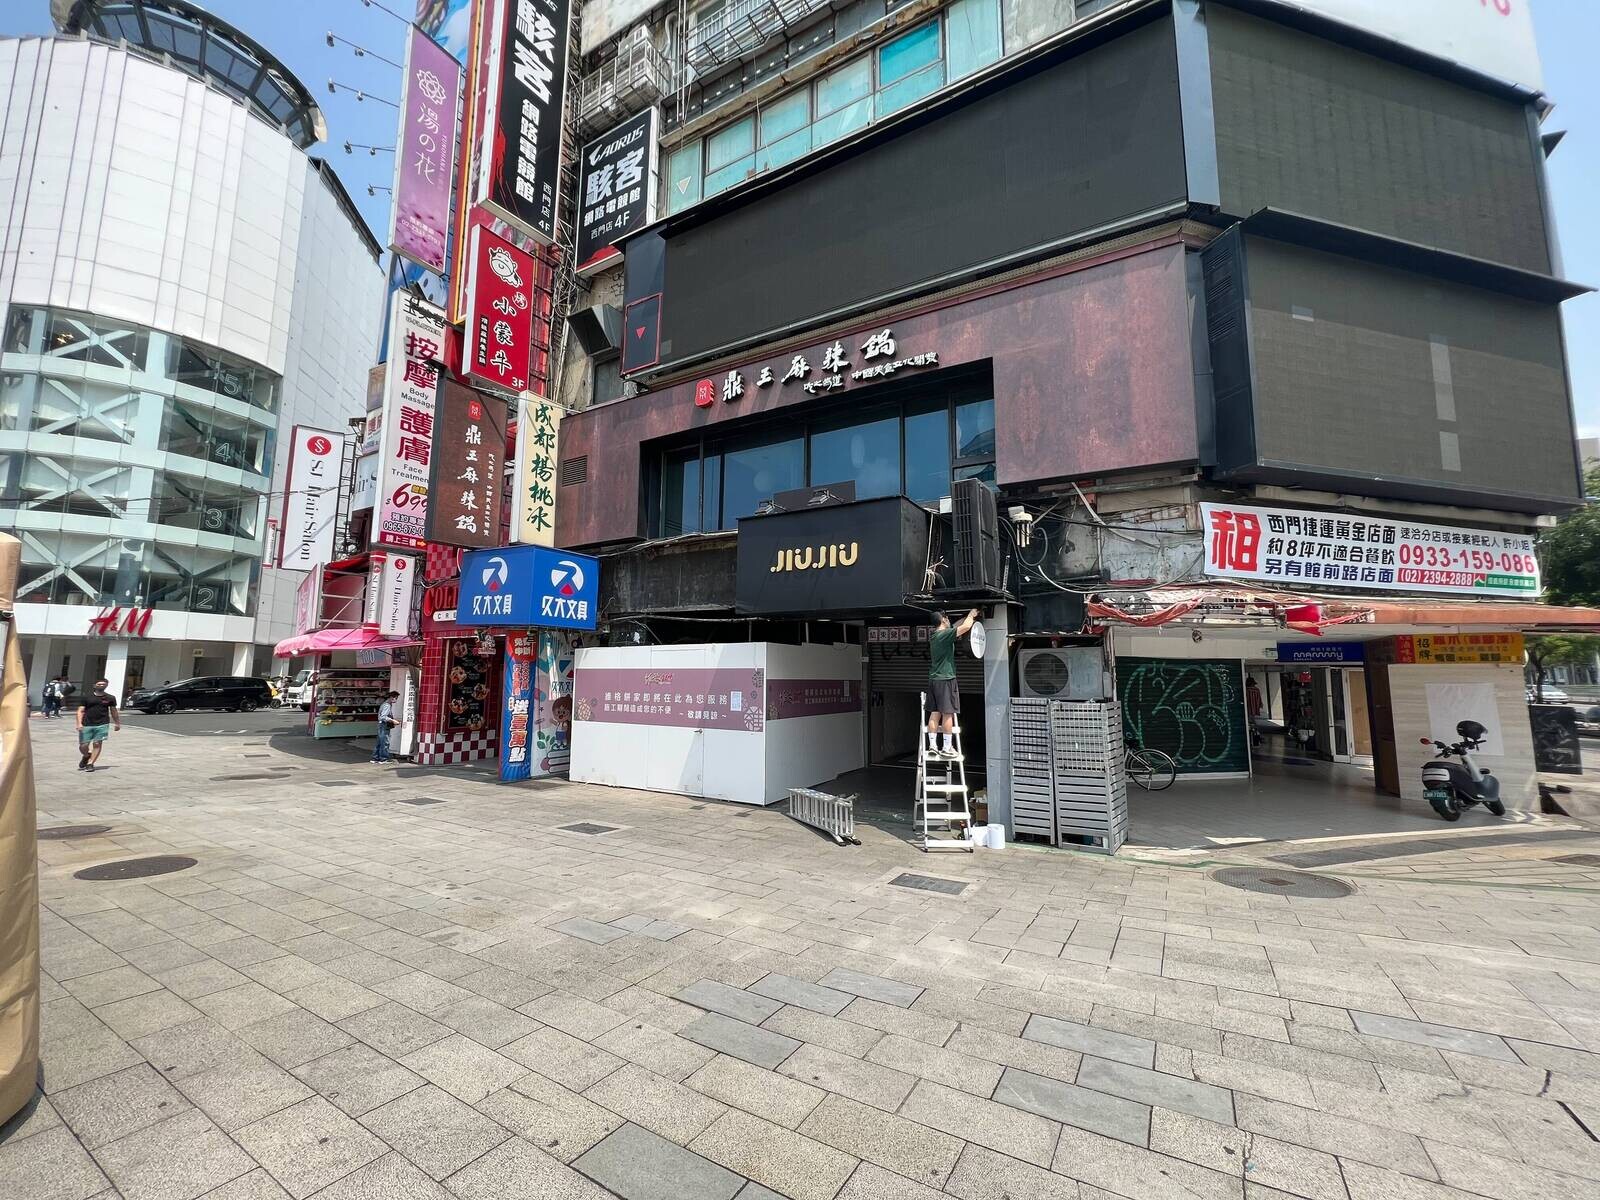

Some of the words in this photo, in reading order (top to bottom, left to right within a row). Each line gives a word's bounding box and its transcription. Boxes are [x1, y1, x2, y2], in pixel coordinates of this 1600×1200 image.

[414, 102, 440, 185] 湯の花
[585, 147, 645, 208] 駭客
[541, 182, 552, 218] 西門店
[538, 219, 551, 231] 4F
[590, 220, 613, 240] 西門店
[614, 210, 630, 228] 4F
[490, 296, 516, 376] 小蒙牛
[403, 332, 439, 389] 按摩
[722, 328, 898, 402] 鼎王麻辣鍋
[223, 376, 241, 396] 5
[409, 387, 429, 400] Body
[511, 376, 525, 388] 3F
[401, 391, 435, 410] Massage
[396, 405, 434, 466] 護膚
[215, 442, 231, 461] 4
[403, 463, 423, 475] Face
[453, 424, 482, 535] 鼎王麻辣鍋
[527, 402, 556, 533] 成都楊桃冰
[305, 485, 321, 520] Hair
[205, 508, 222, 528] 3
[1266, 514, 1396, 545] 西門捷運黃金店面
[300, 521, 316, 560] Salon
[1209, 510, 1262, 572] 租
[1266, 537, 1395, 565] 約8坪不適合餐飲
[1265, 558, 1394, 583] 另有館前路店面
[1399, 544, 1535, 573] 0933-159-086
[1400, 568, 1422, 583] (02)
[1423, 570, 1473, 586] 2394-2888
[197, 587, 213, 610] 2
[473, 594, 513, 615] 久大文具
[541, 595, 588, 621] 久大文具
[87, 606, 153, 637] H&M
